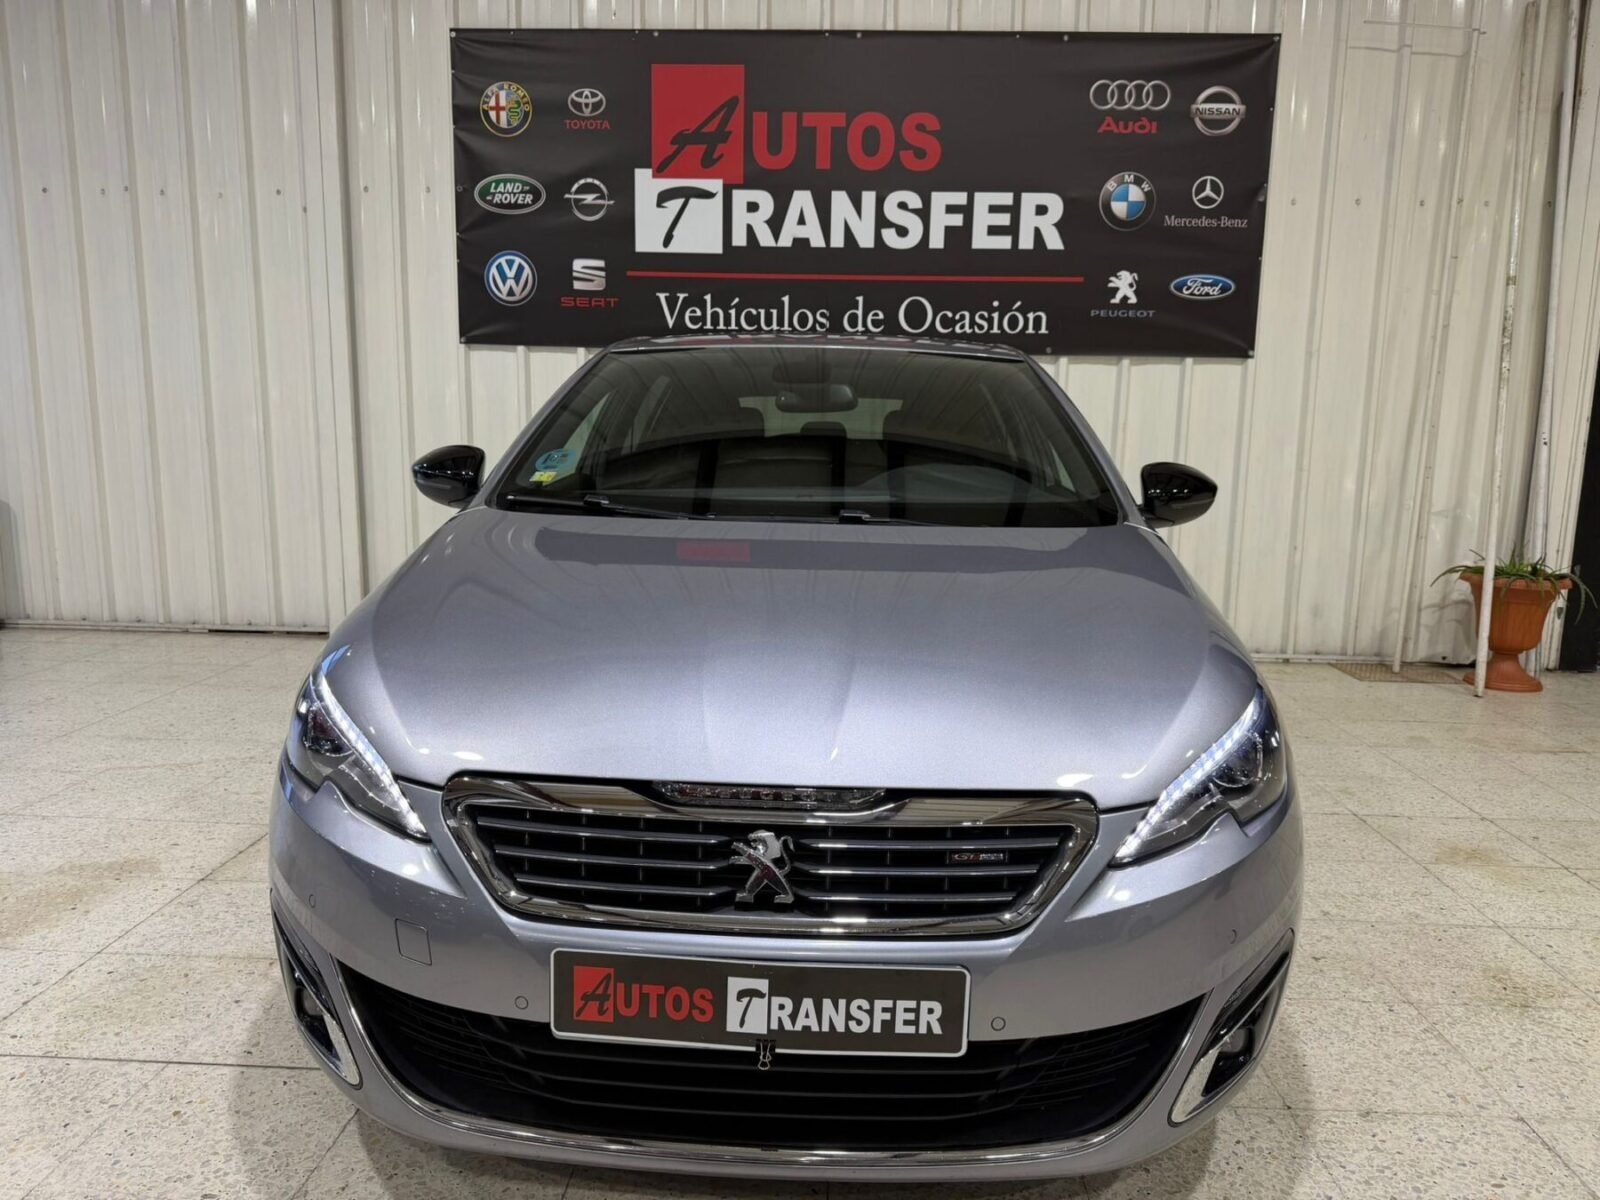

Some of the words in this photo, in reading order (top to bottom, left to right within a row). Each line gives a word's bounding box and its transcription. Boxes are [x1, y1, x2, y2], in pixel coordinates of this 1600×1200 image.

[482, 85, 500, 111] ALFA
[503, 83, 530, 112] ROMEO
[1194, 106, 1241, 116] NISSAN
[564, 120, 610, 129] TOYOTA
[1097, 116, 1158, 134] Audi
[656, 95, 942, 174] AUTOS
[490, 182, 522, 193] LAND
[1106, 174, 1151, 192] BMW
[493, 193, 533, 205] ROVER
[656, 185, 1065, 251] TRANSFER
[1164, 215, 1248, 228] Mercedes-Benz
[1182, 278, 1222, 296] Ford
[561, 297, 619, 308] SEAT
[656, 292, 830, 333] Vehículos
[842, 294, 884, 334] de
[898, 296, 1049, 336] Ocasión
[1090, 309, 1156, 318] PEUGEOT
[575, 973, 714, 1023] AUTOS
[736, 987, 943, 1035] TRANSFER
